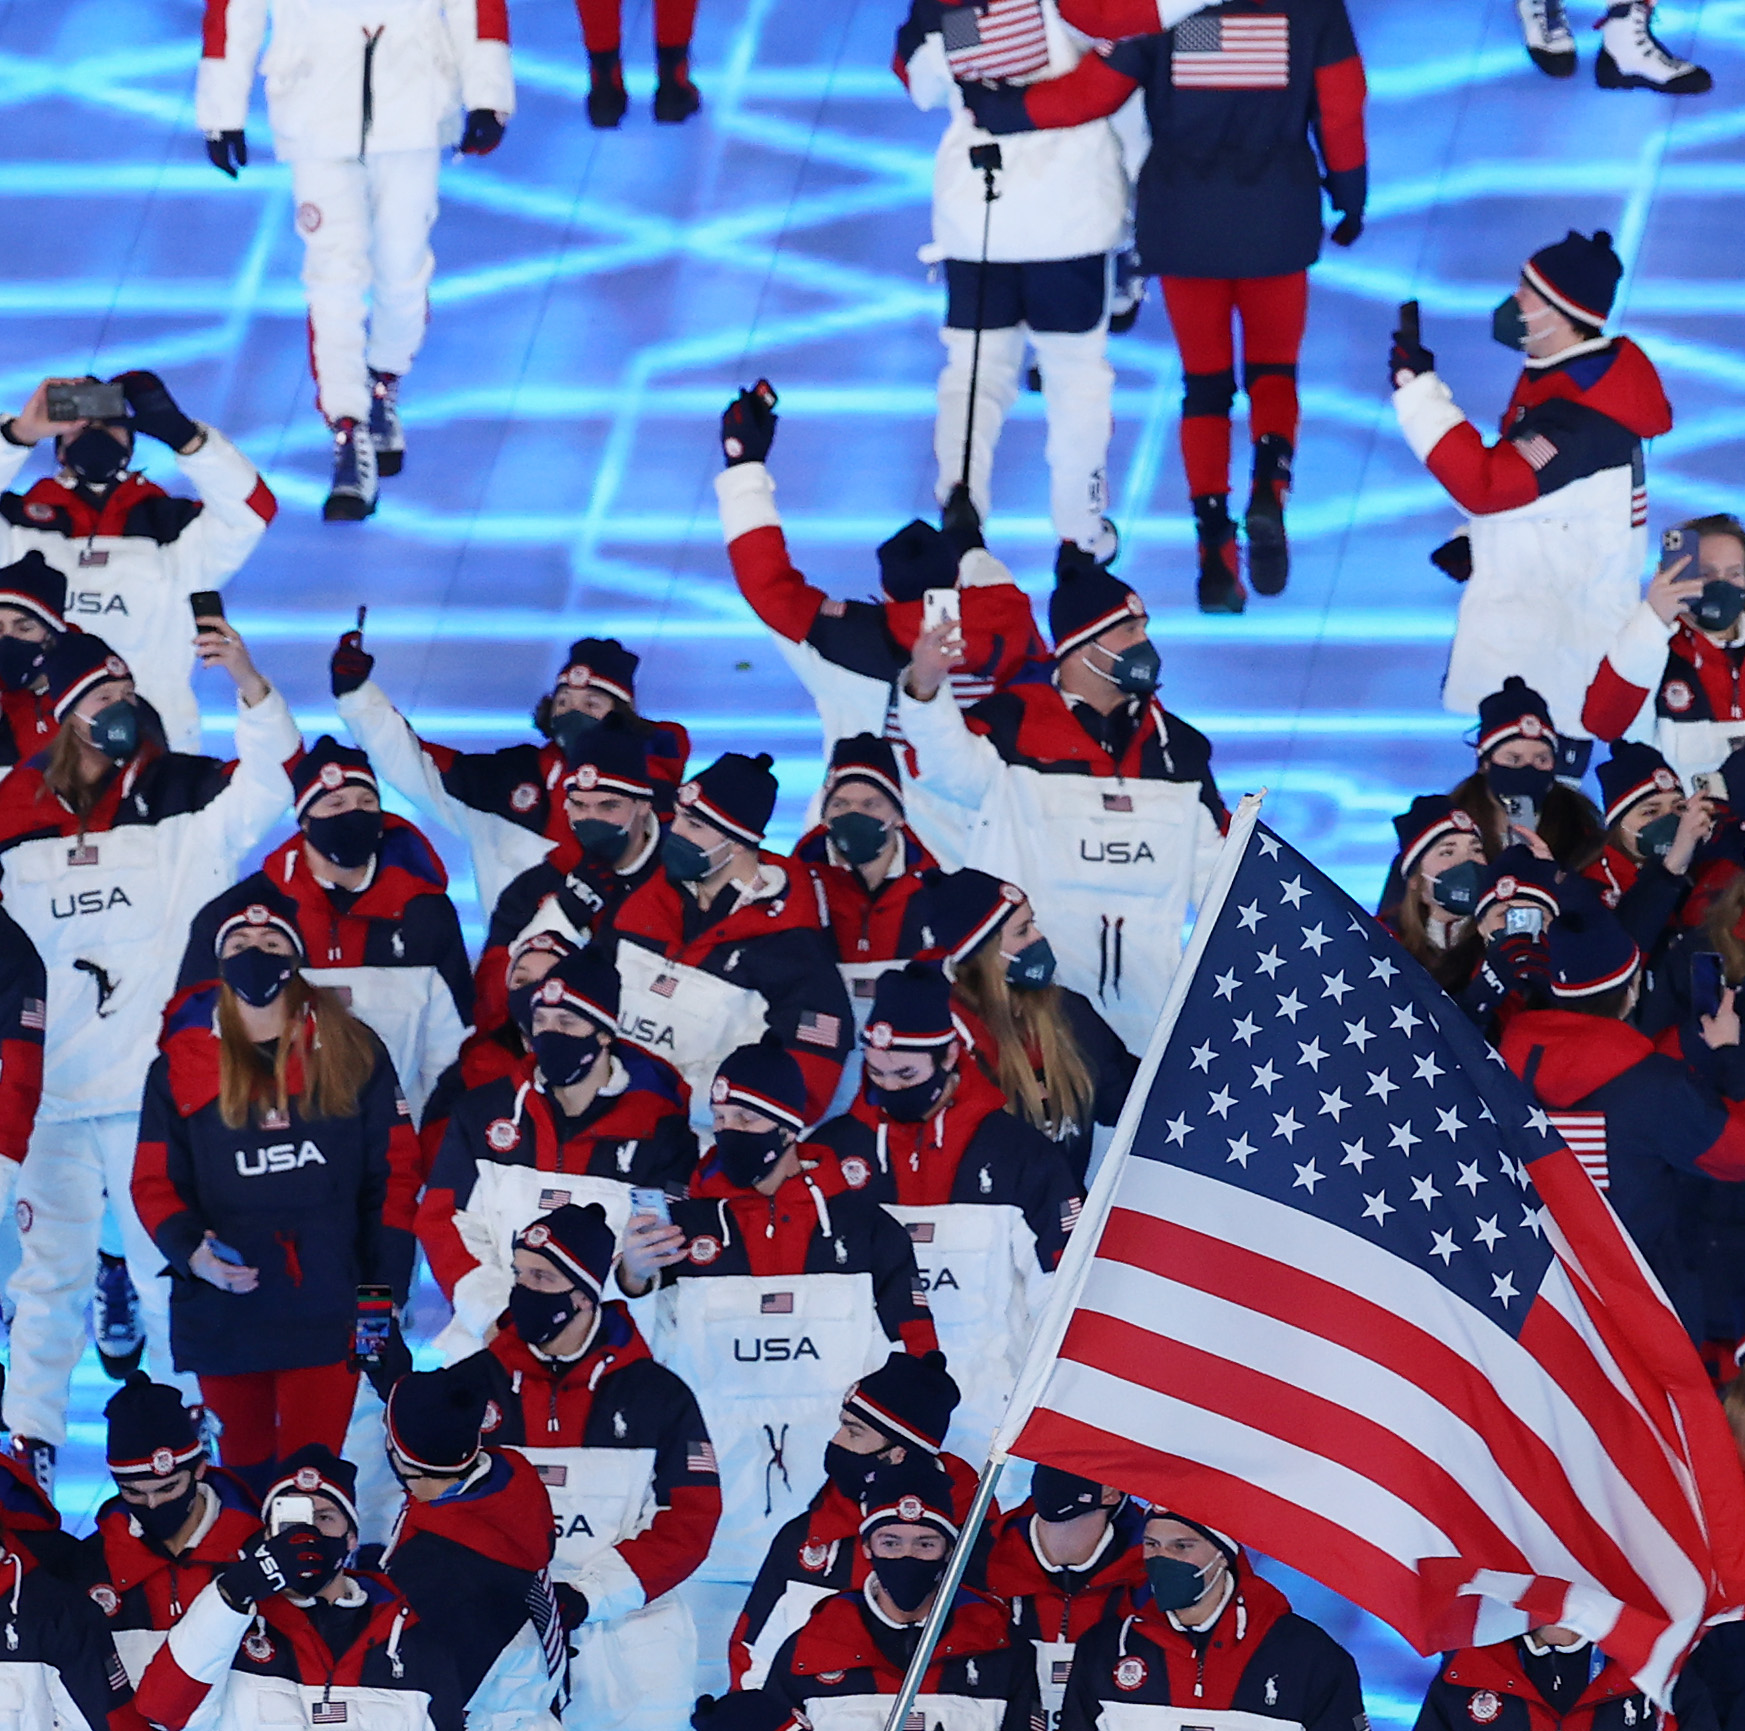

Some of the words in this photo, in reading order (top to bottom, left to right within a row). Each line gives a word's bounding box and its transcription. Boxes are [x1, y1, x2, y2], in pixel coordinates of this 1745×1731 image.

[1081, 839, 1154, 864] USA
[52, 886, 131, 919] USA
[620, 1010, 675, 1049] USA
[236, 1141, 326, 1177] USA
[916, 1267, 959, 1291] SA
[734, 1338, 820, 1361] USA
[553, 1516, 594, 1539] SA
[256, 1544, 286, 1592] USA
